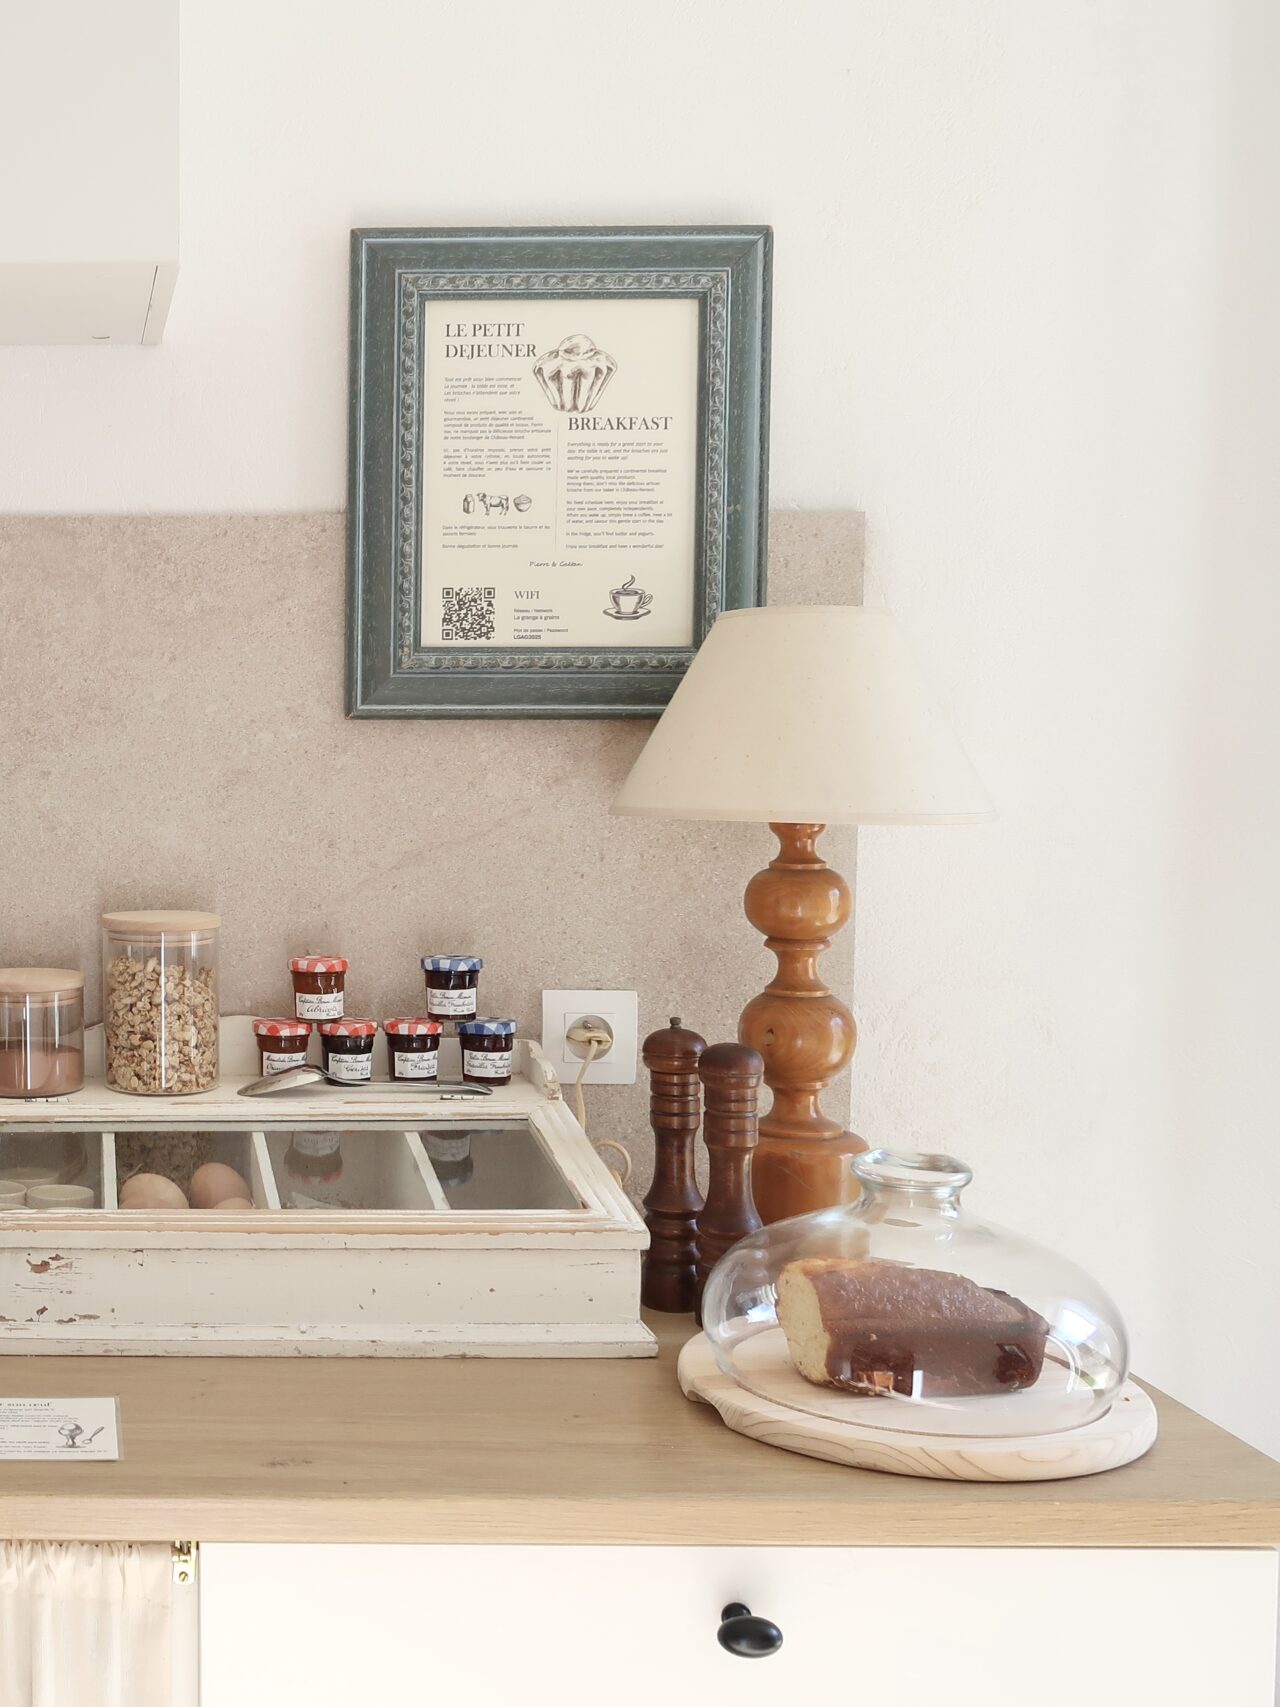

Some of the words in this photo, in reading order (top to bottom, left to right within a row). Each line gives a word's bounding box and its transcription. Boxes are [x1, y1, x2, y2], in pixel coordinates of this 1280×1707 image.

[445, 323, 468, 337] LE
[472, 323, 525, 337] PETIT
[445, 344, 537, 360] DEJEUNER
[568, 416, 673, 431] BREAKFAST
[514, 590, 540, 600] WIFI
